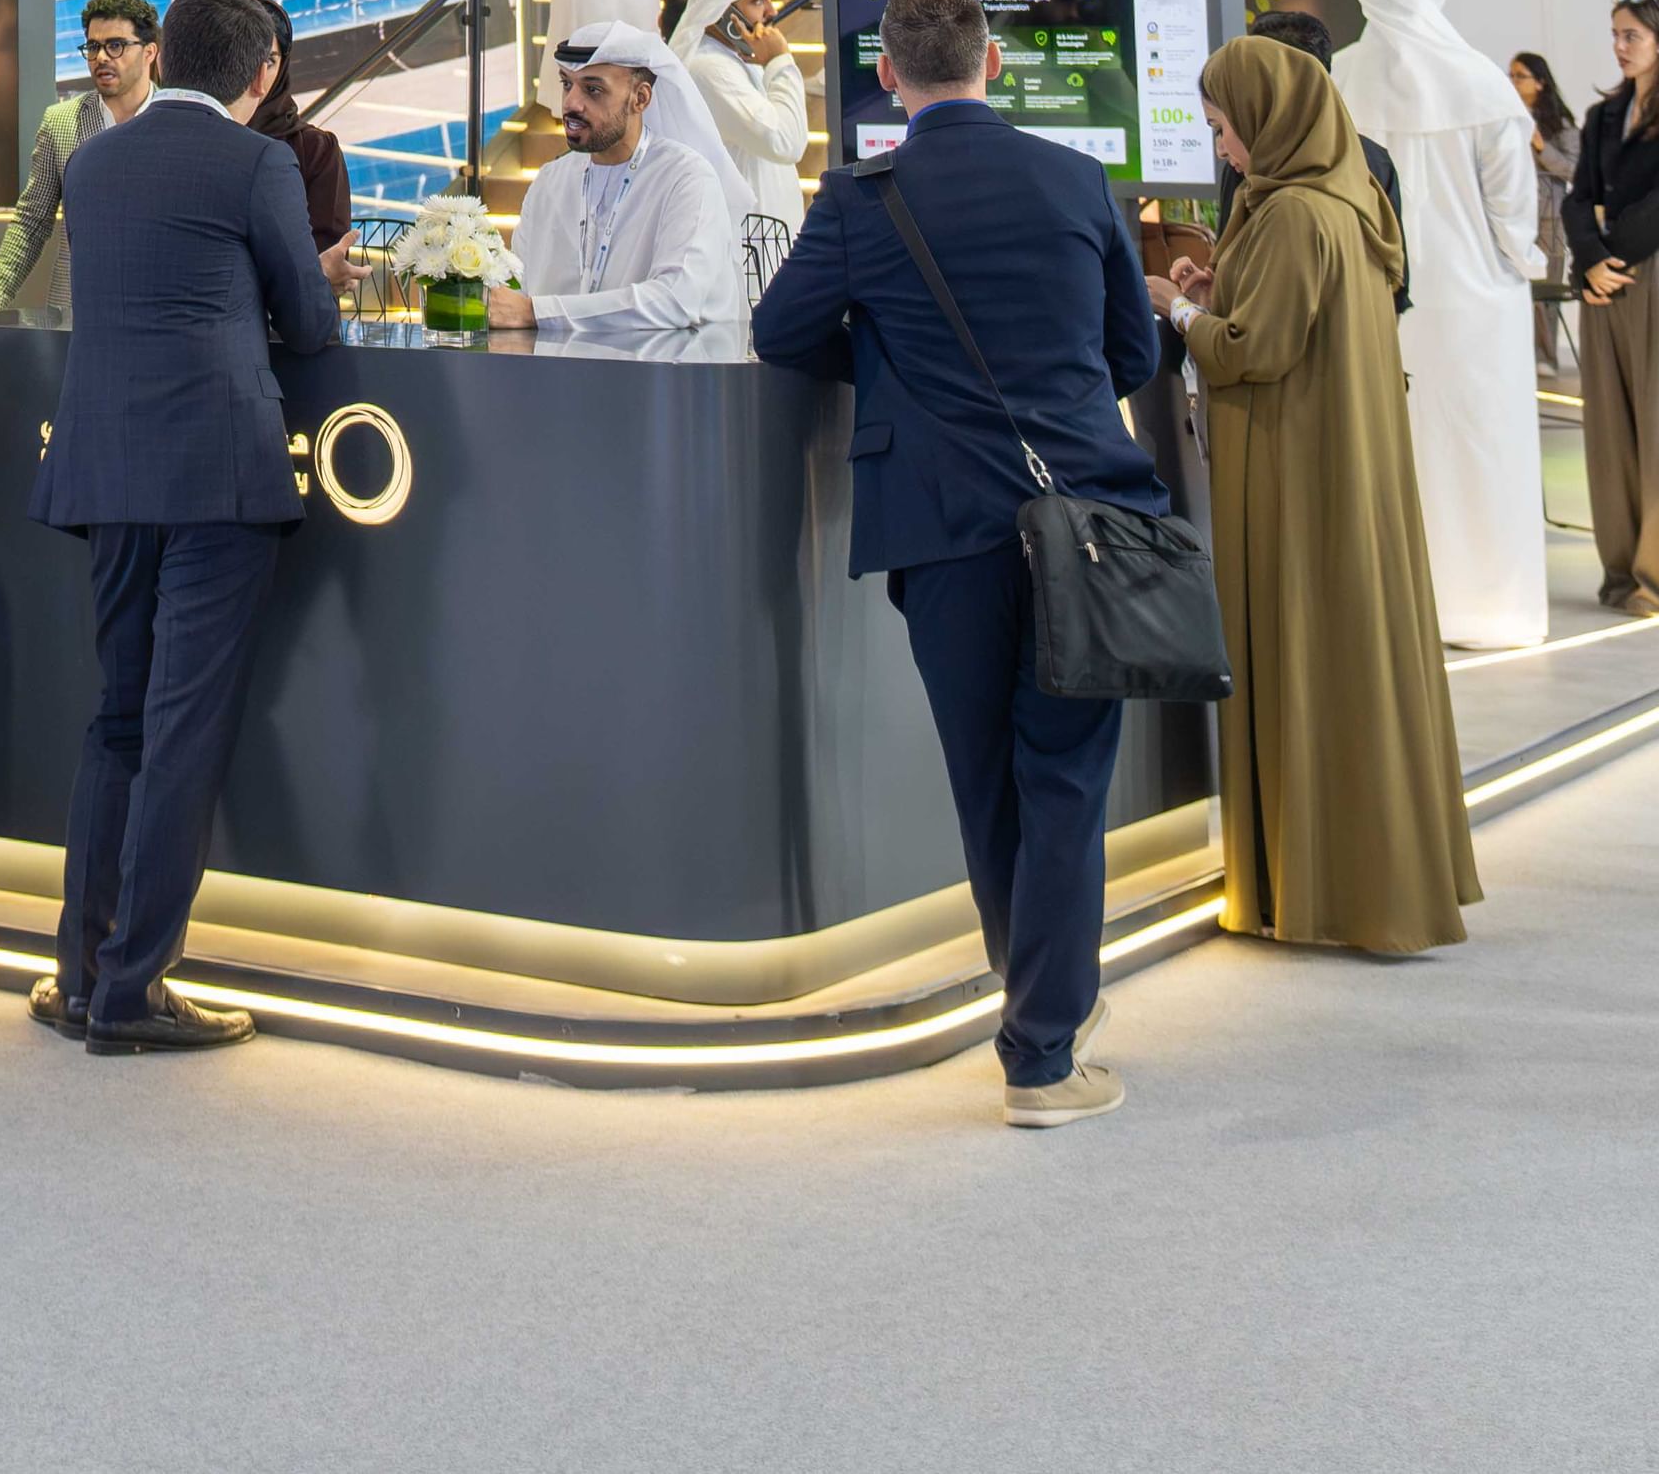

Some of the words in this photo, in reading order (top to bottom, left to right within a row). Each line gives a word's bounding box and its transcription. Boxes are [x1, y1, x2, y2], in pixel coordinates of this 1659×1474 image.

[983, 3, 1030, 12] Transformation
[1150, 107, 1194, 124] 100+
[1152, 138, 1173, 148] 150+
[1181, 138, 1202, 148] 200+
